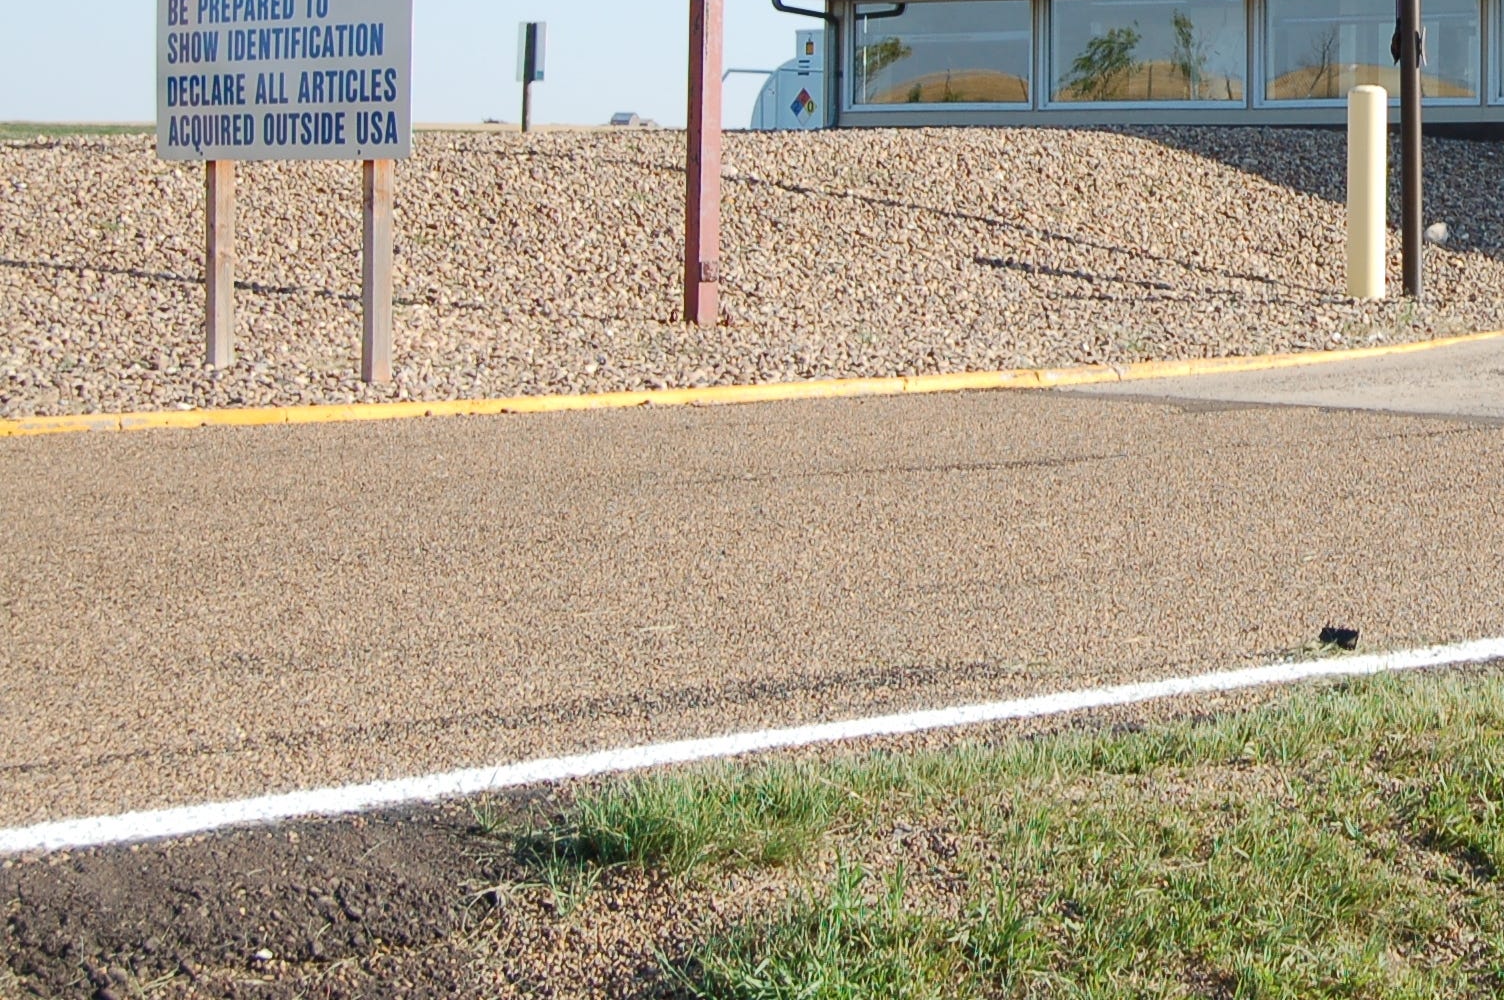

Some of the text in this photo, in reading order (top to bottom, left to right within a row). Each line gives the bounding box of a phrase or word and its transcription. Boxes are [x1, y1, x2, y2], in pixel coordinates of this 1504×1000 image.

[168, 23, 384, 64] SHOW IDENTIFICATION
[167, 68, 397, 107] DECLARE ALL ARTICLES
[168, 111, 398, 152] ACQUIRED OUTSIDE USA
